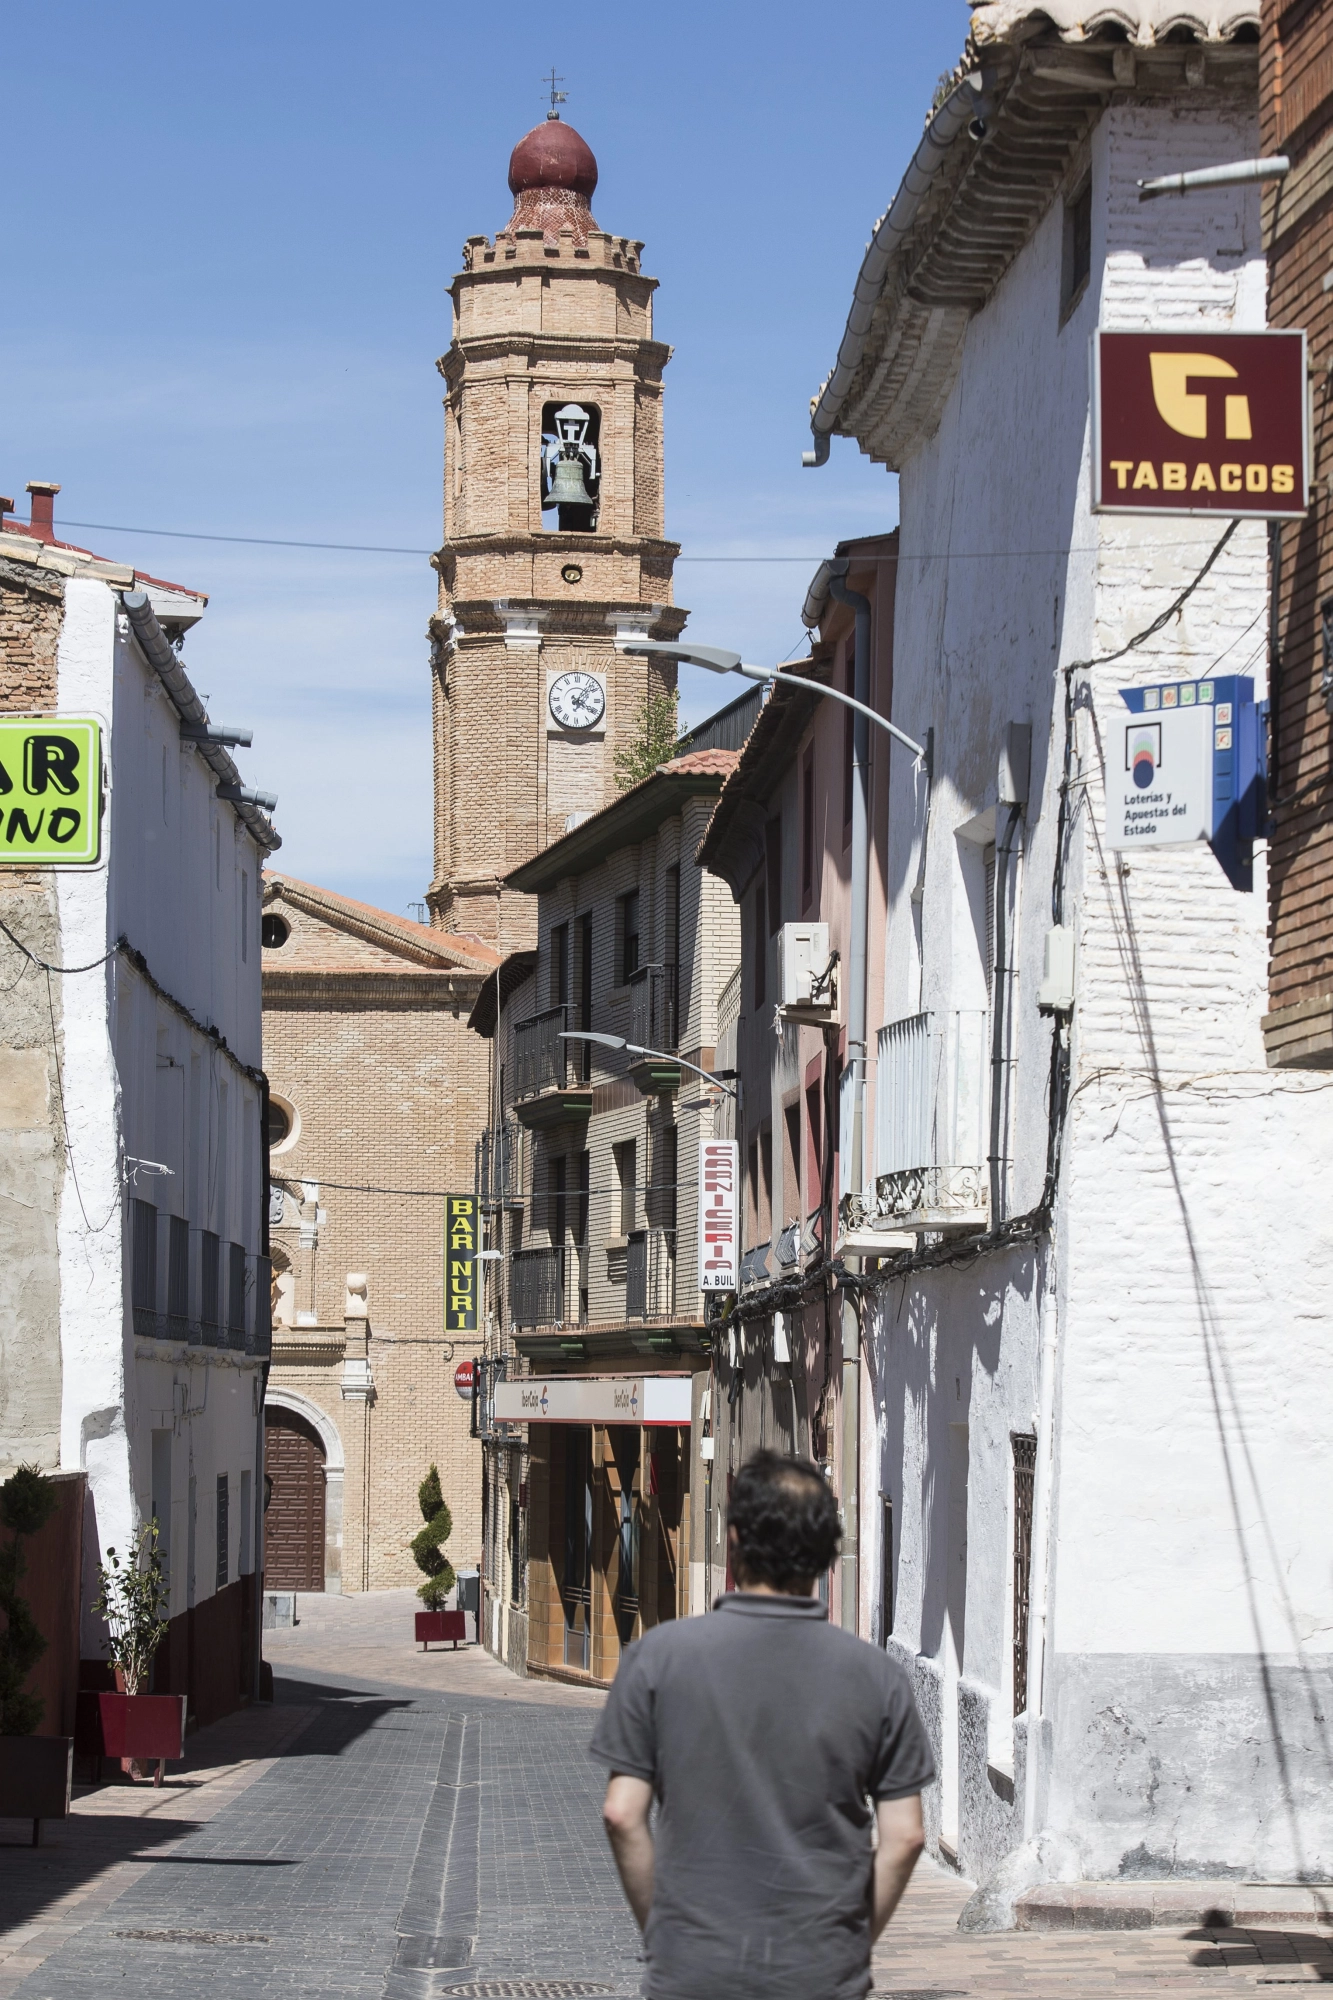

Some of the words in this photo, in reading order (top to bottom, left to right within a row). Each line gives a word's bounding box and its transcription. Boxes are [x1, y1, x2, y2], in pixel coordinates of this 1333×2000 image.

[1109, 460, 1295, 494] TABACOS
[0, 735, 80, 796] R
[1124, 791, 1164, 806] Loterías
[1166, 793, 1172, 805] y
[1124, 807, 1169, 823] Apuestas
[1172, 803, 1187, 816] del
[0, 807, 81, 844] NO
[1124, 822, 1157, 837] Estado
[451, 1200, 474, 1250] BAR
[704, 1146, 733, 1270] CARNICERIA
[451, 1261, 474, 1329] NURI
[703, 1275, 712, 1286] A.
[714, 1275, 734, 1286] BUIL
